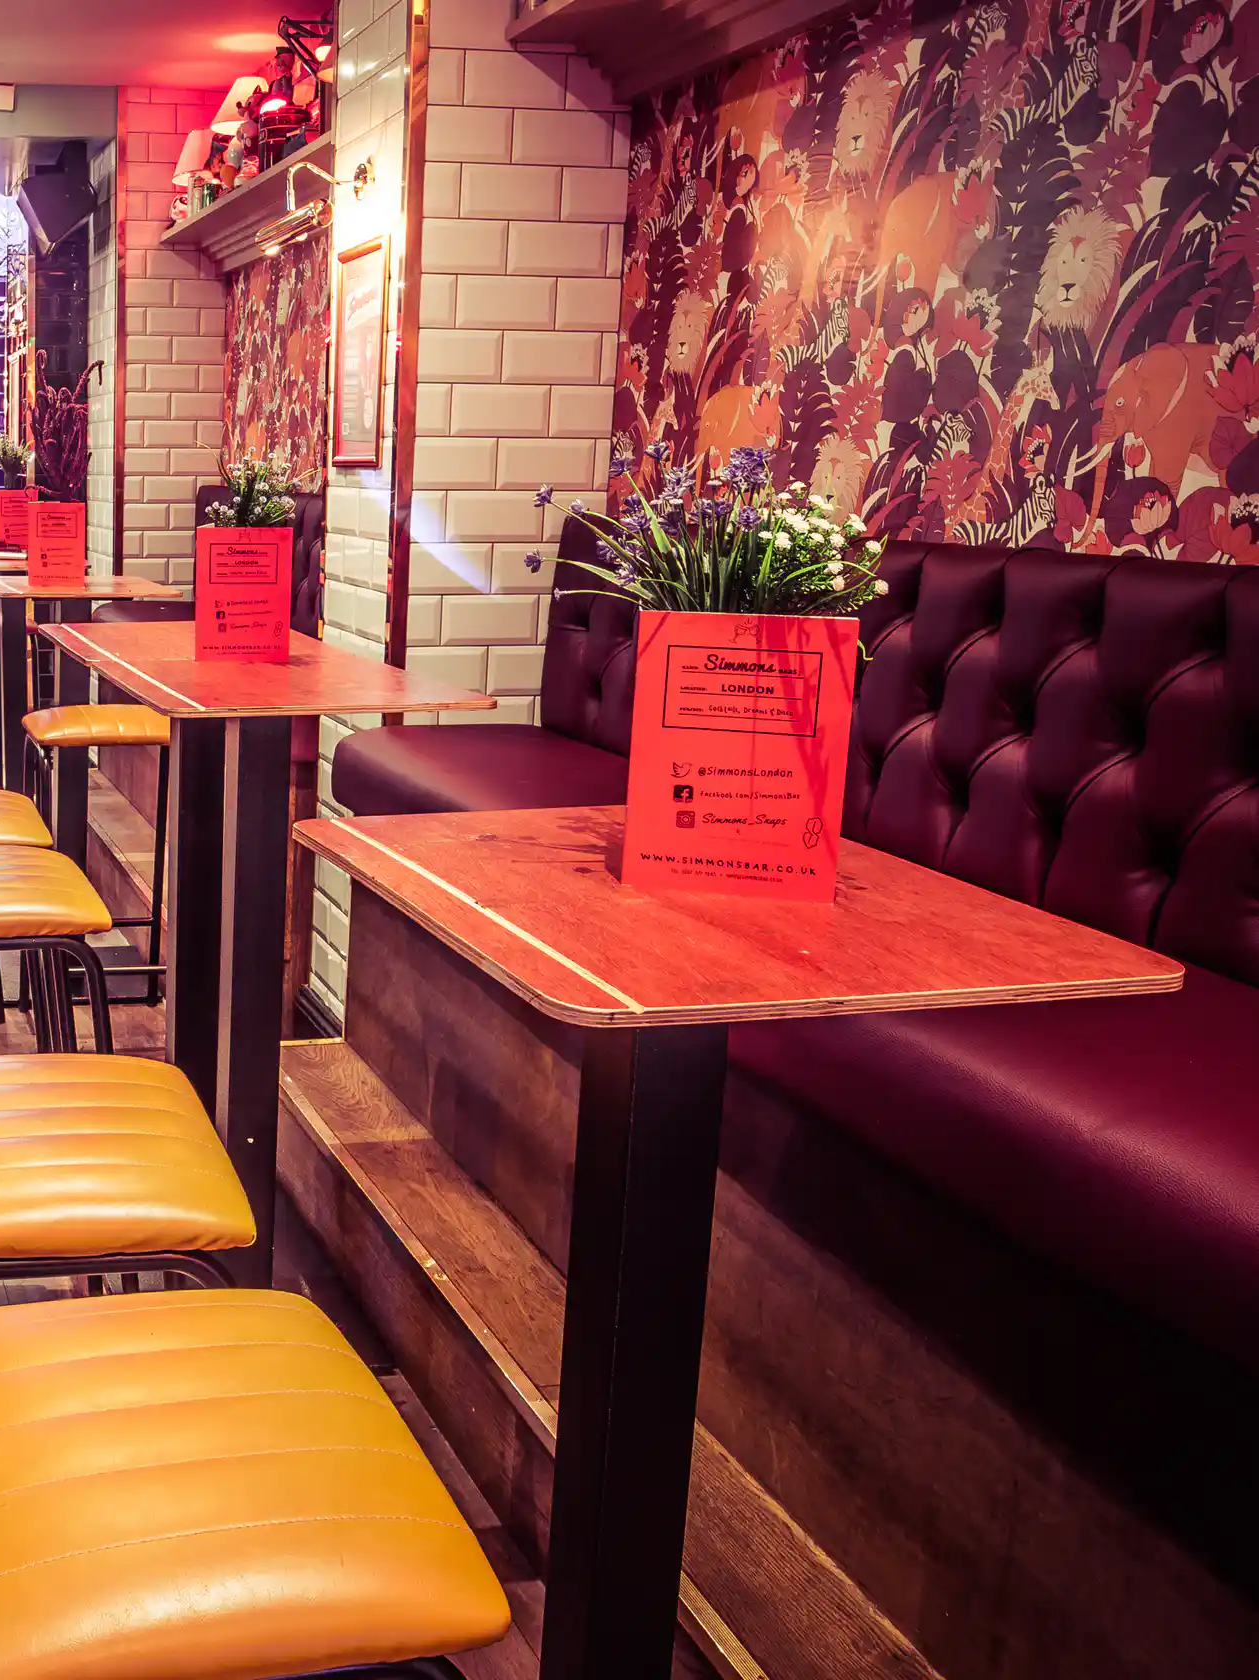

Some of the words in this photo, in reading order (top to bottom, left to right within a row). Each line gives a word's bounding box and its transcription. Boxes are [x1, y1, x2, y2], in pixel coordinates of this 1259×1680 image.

[704, 653, 776, 674] Simmons
[721, 684, 775, 695] LONDON
[743, 706, 768, 715] Dreams
[776, 708, 794, 717] Disco
[697, 766, 793, 779] @SimmonsLondon
[702, 812, 788, 828] Simmons_Snaps
[640, 852, 817, 876] WWW.SIMMONSBAR.CO.UK
